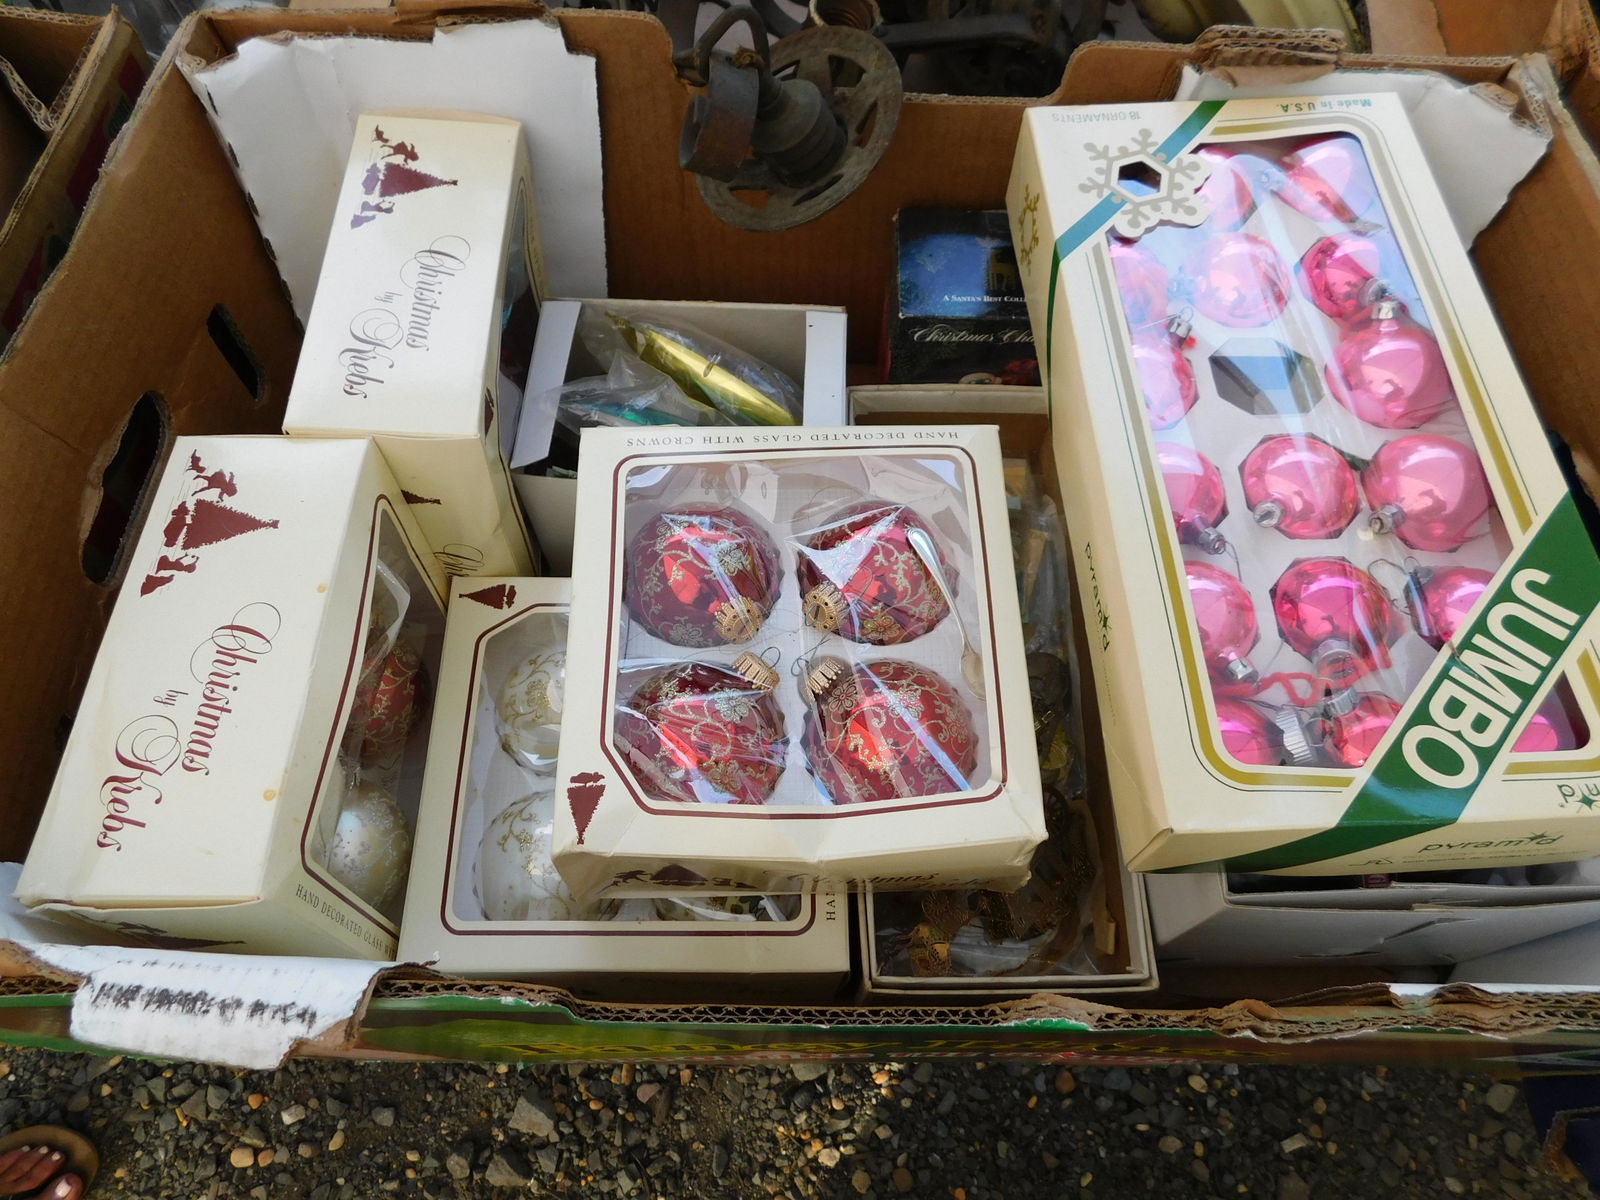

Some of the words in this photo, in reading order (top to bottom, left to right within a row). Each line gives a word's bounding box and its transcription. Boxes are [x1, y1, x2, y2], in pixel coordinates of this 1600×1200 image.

[1276, 102, 1316, 113] U.S.A.
[1337, 98, 1372, 108] Made
[1051, 111, 1127, 123] ORNAMENTS
[1128, 111, 1142, 121] 18
[374, 291, 402, 304] by
[400, 235, 471, 351] Christmas
[909, 323, 994, 344] Christmas
[999, 328, 1035, 345] Cha
[338, 308, 404, 399] Krebs
[703, 436, 745, 444] WITH
[753, 434, 802, 443] GLASS
[810, 432, 905, 441] DECORATED
[914, 431, 959, 439] HAND
[626, 437, 694, 447] CROWNS
[1402, 568, 1581, 789] JUMBO
[182, 602, 281, 776] Christmas
[153, 689, 189, 706] by
[97, 714, 182, 852] Krebs
[295, 884, 321, 909] HAND
[321, 901, 363, 938] DECORATED
[363, 930, 383, 952] GLASS
